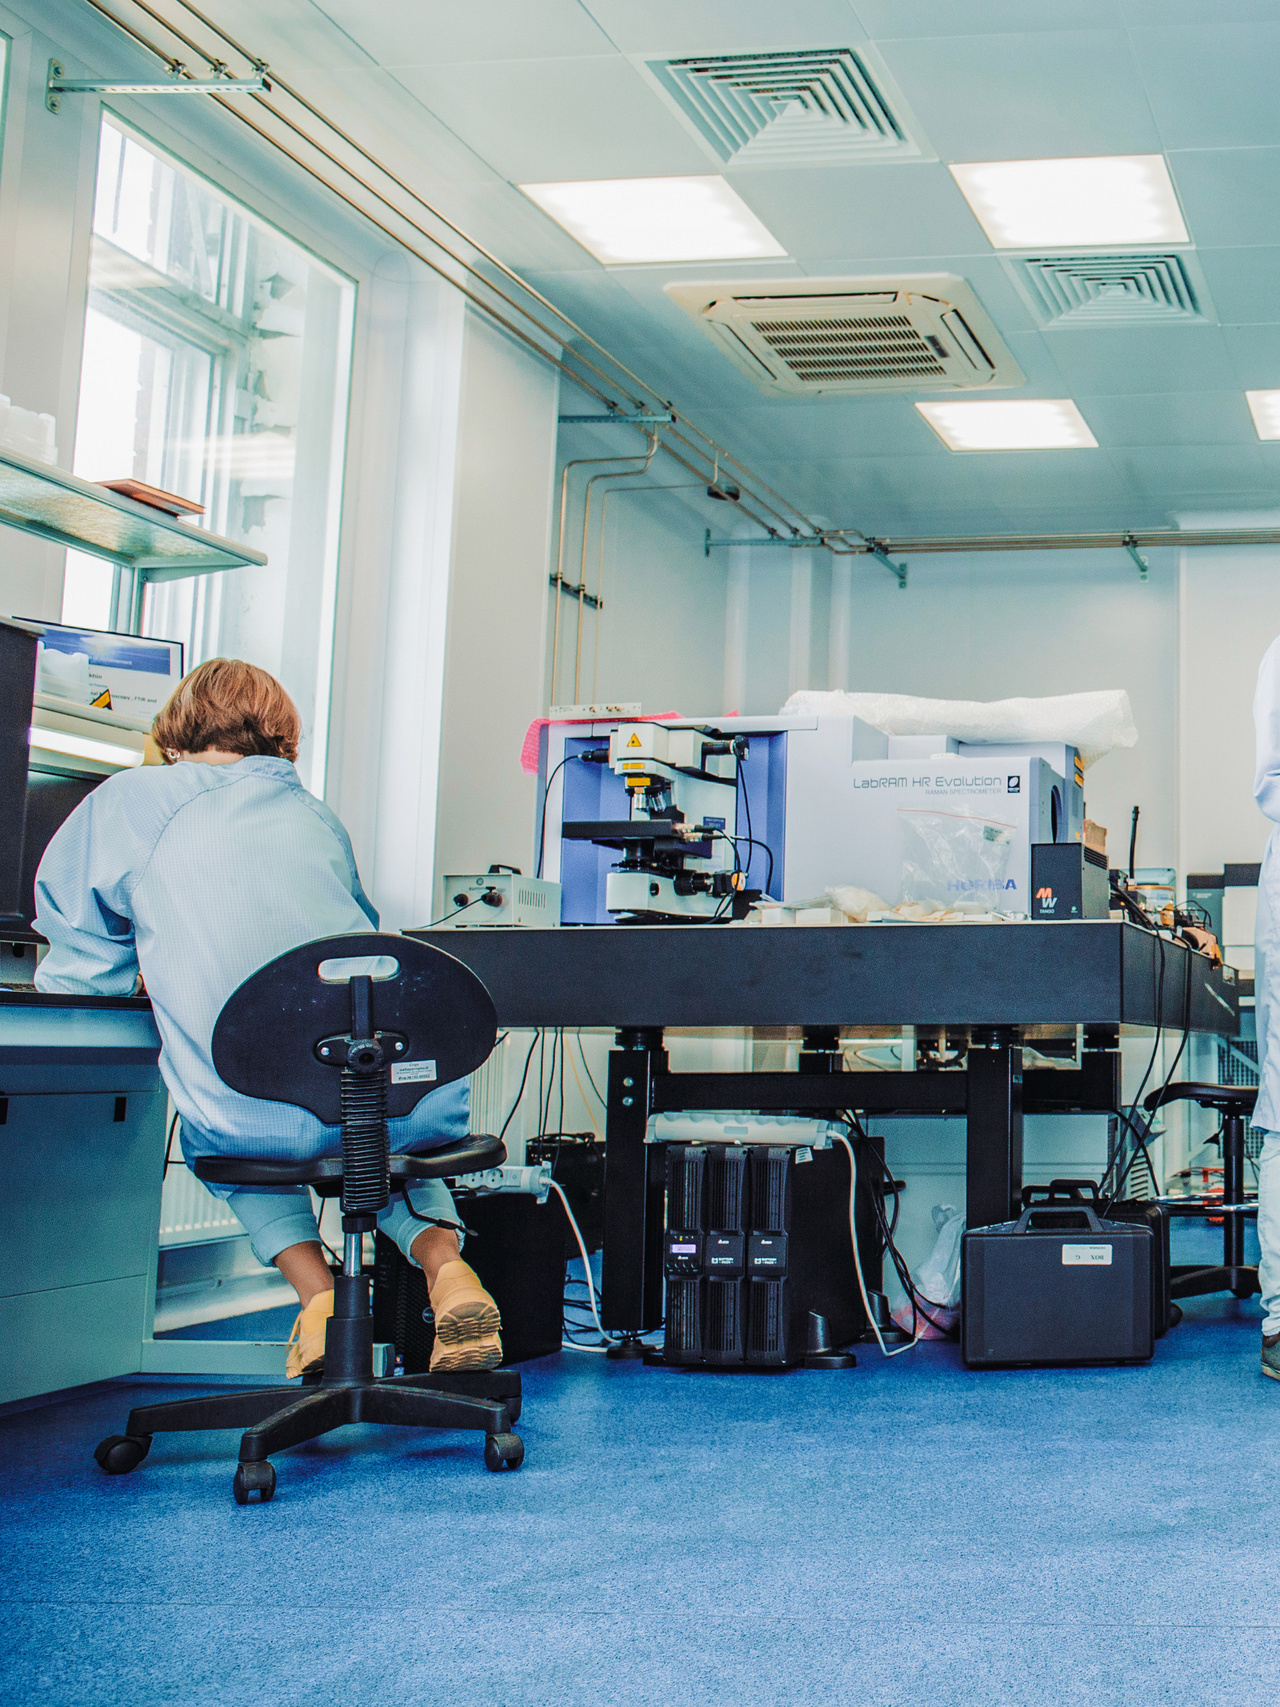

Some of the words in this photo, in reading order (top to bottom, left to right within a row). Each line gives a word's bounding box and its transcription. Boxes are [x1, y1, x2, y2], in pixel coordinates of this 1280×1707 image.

[853, 777, 908, 789] LabRAM
[912, 776, 931, 787] HR
[935, 775, 1002, 787] Evolution
[946, 878, 1017, 891] HORIBA
